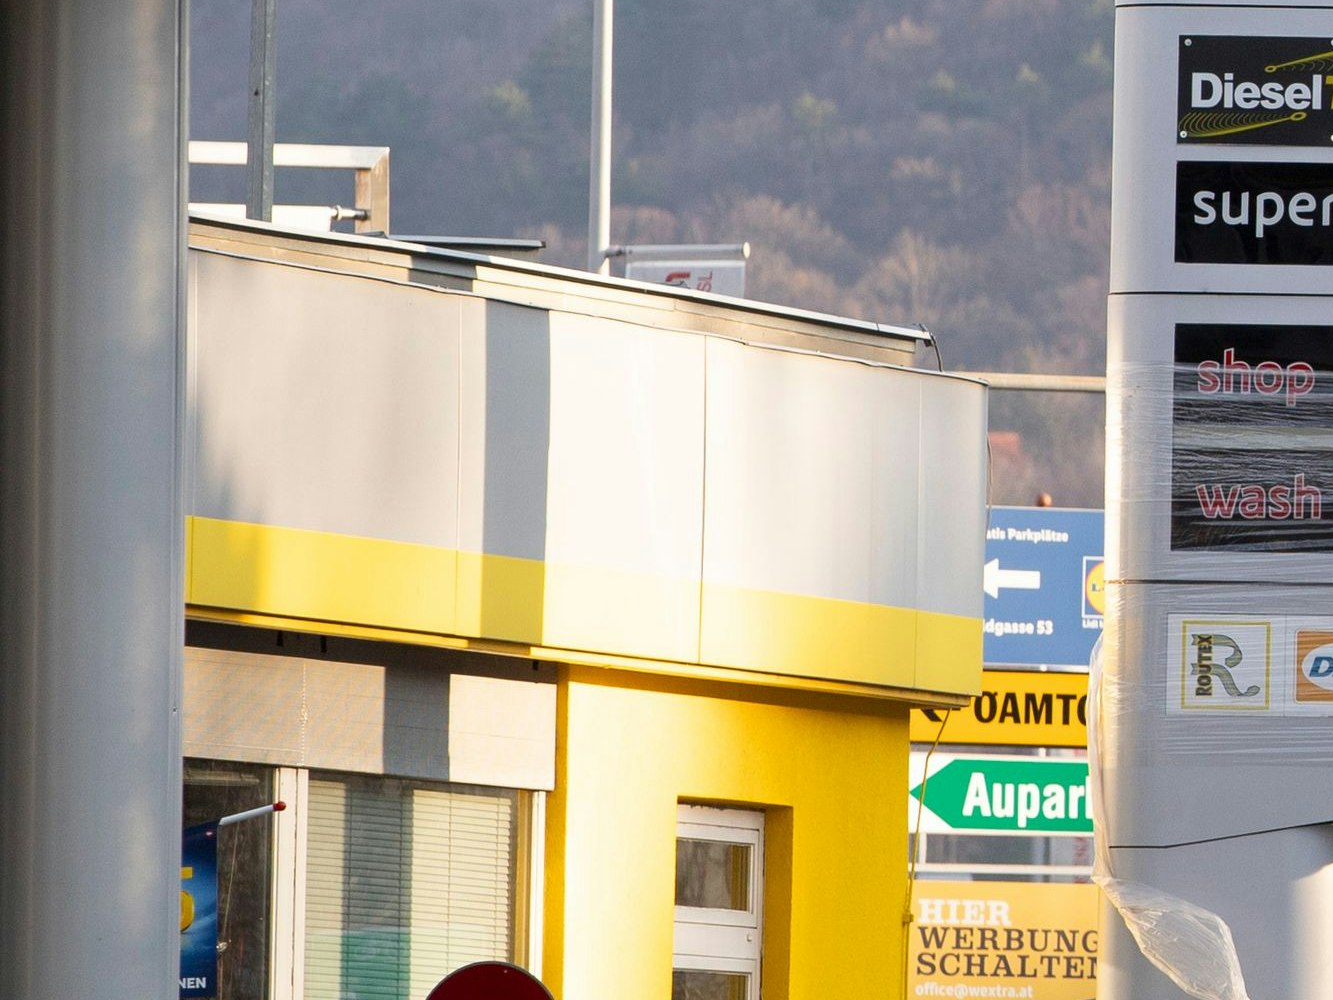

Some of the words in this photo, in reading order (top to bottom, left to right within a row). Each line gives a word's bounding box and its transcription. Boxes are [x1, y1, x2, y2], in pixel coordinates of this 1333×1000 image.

[1196, 347, 1317, 407] shop
[1195, 472, 1324, 522] wash
[1007, 527, 1069, 545] Parkplätze
[983, 617, 1034, 637] dgasse
[1036, 619, 1054, 635] 53
[1194, 633, 1214, 697] ROUTEX
[917, 898, 1011, 927] HIER
[918, 926, 1098, 954] WERBUNG
[915, 981, 1034, 999] office@wextra.at
